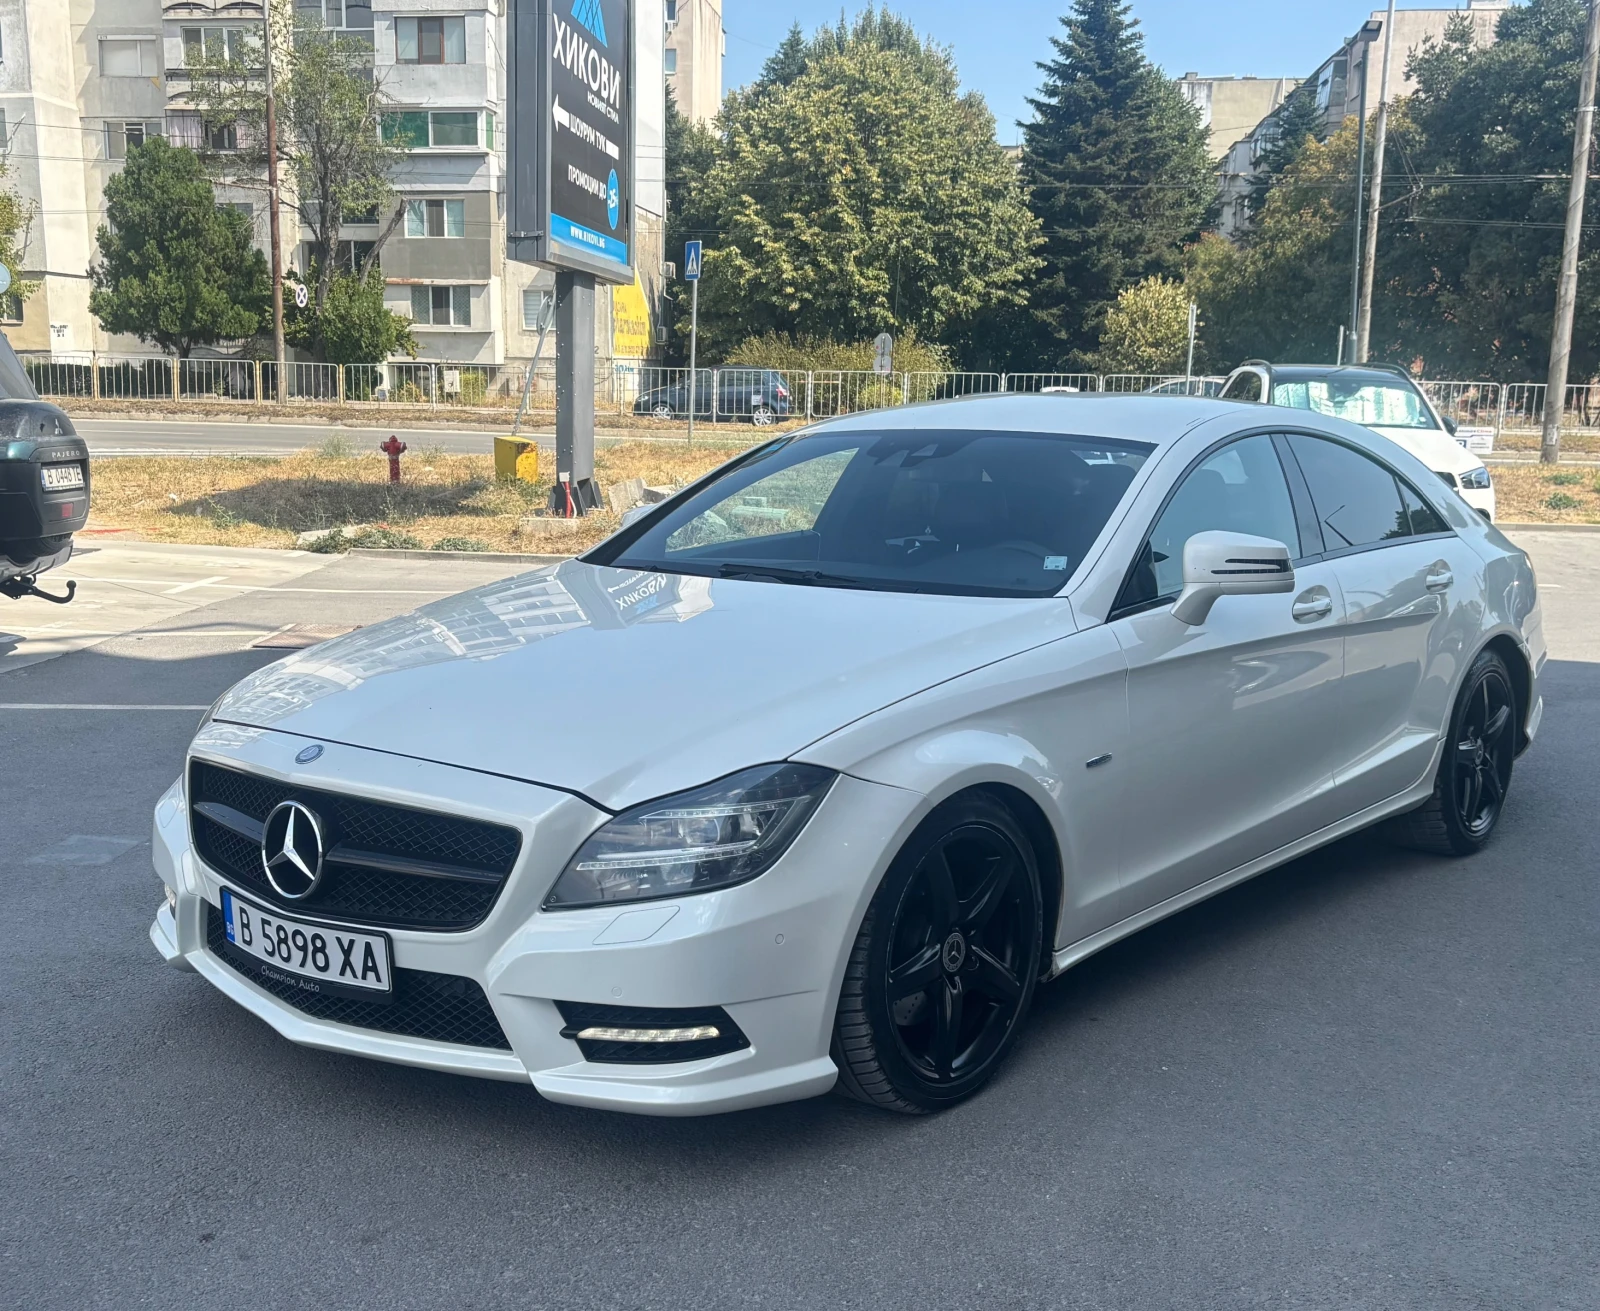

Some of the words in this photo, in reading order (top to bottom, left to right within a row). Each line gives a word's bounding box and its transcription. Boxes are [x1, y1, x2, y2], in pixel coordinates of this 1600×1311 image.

[553, 12, 620, 109] ХИКОВИ
[570, 113, 595, 146] ШОУРУМ
[596, 131, 606, 153] ТУК
[568, 164, 599, 196] ПРОМОЦИИ
[599, 182, 607, 200] ДО
[51, 450, 80, 458] PAJERO
[226, 921, 235, 935] BG
[239, 906, 253, 946] B
[261, 917, 330, 973] 5898
[335, 936, 382, 983] XA
[261, 965, 296, 986] Champion
[300, 980, 320, 993] Auto
